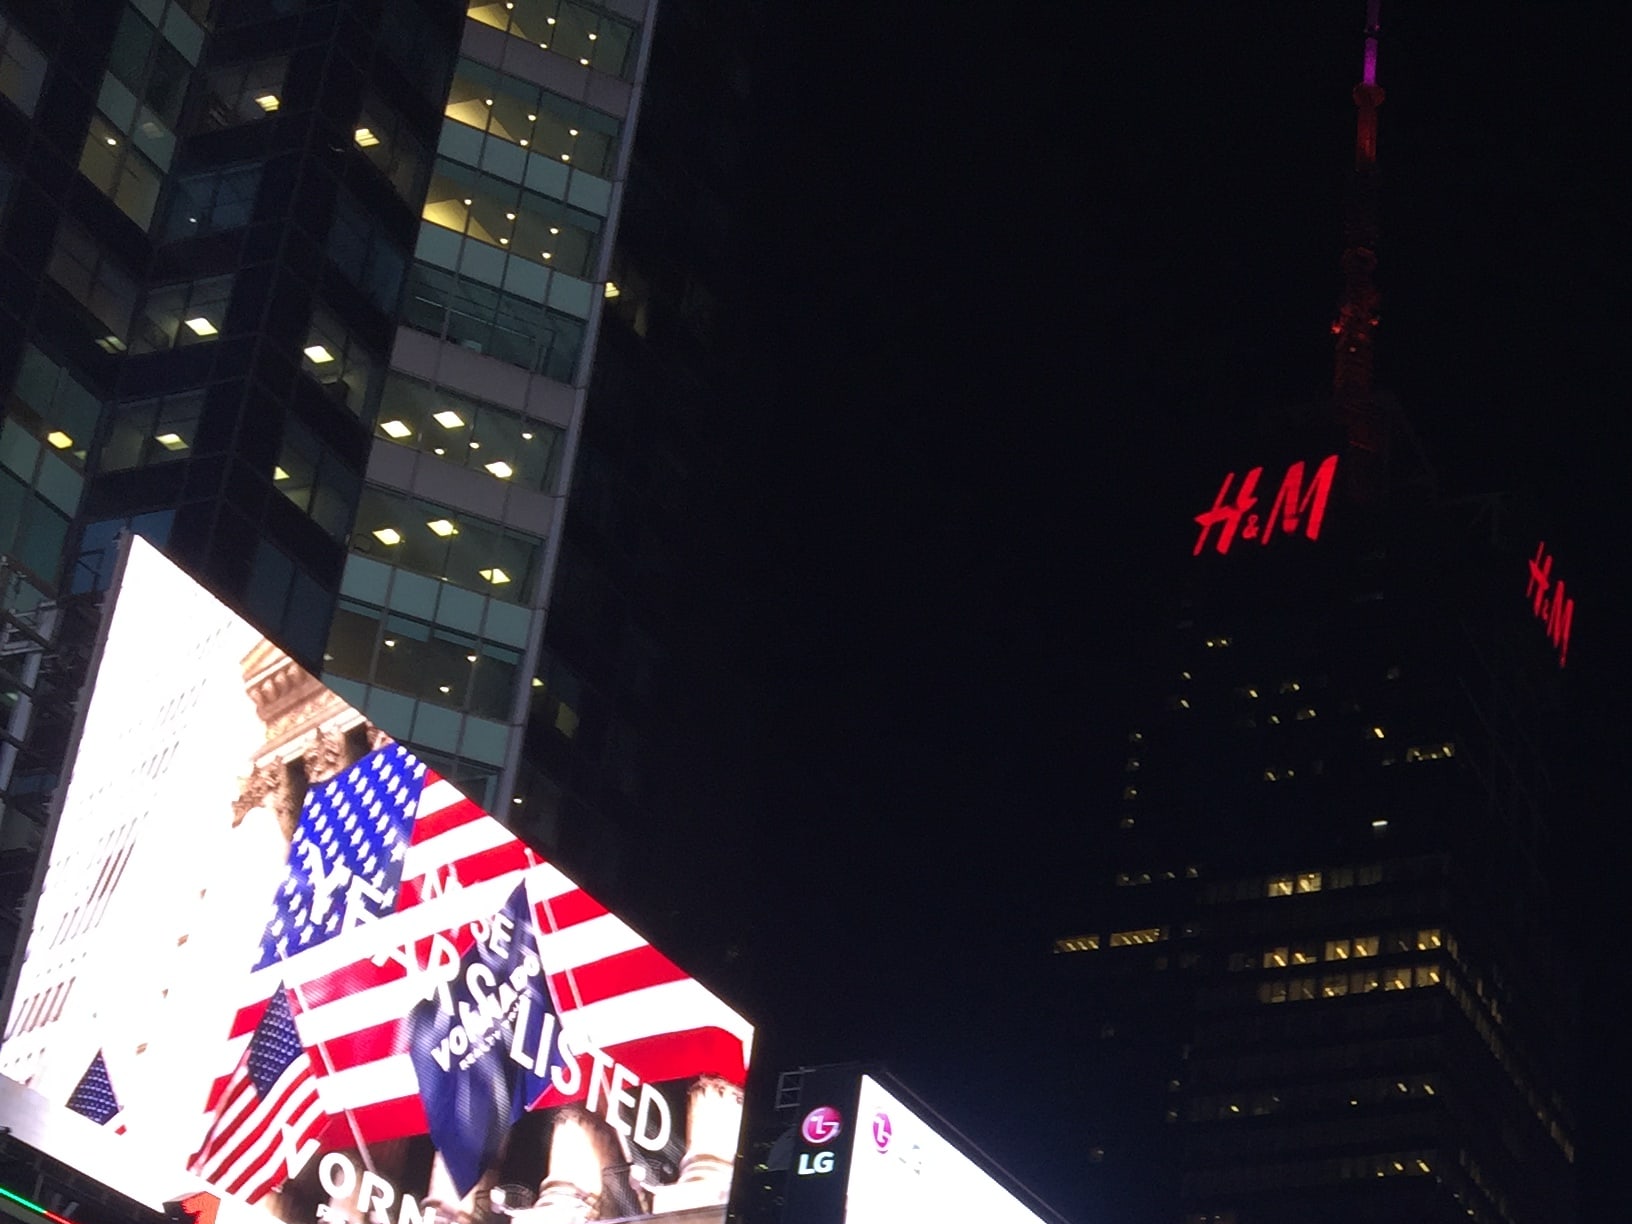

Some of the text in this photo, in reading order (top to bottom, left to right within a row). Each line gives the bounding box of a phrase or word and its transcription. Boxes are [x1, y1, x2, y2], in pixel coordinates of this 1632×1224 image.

[1194, 454, 1340, 556] H&M
[1526, 540, 1575, 669] H&M
[509, 990, 672, 1153] LISTED
[797, 1151, 835, 1175] LG
